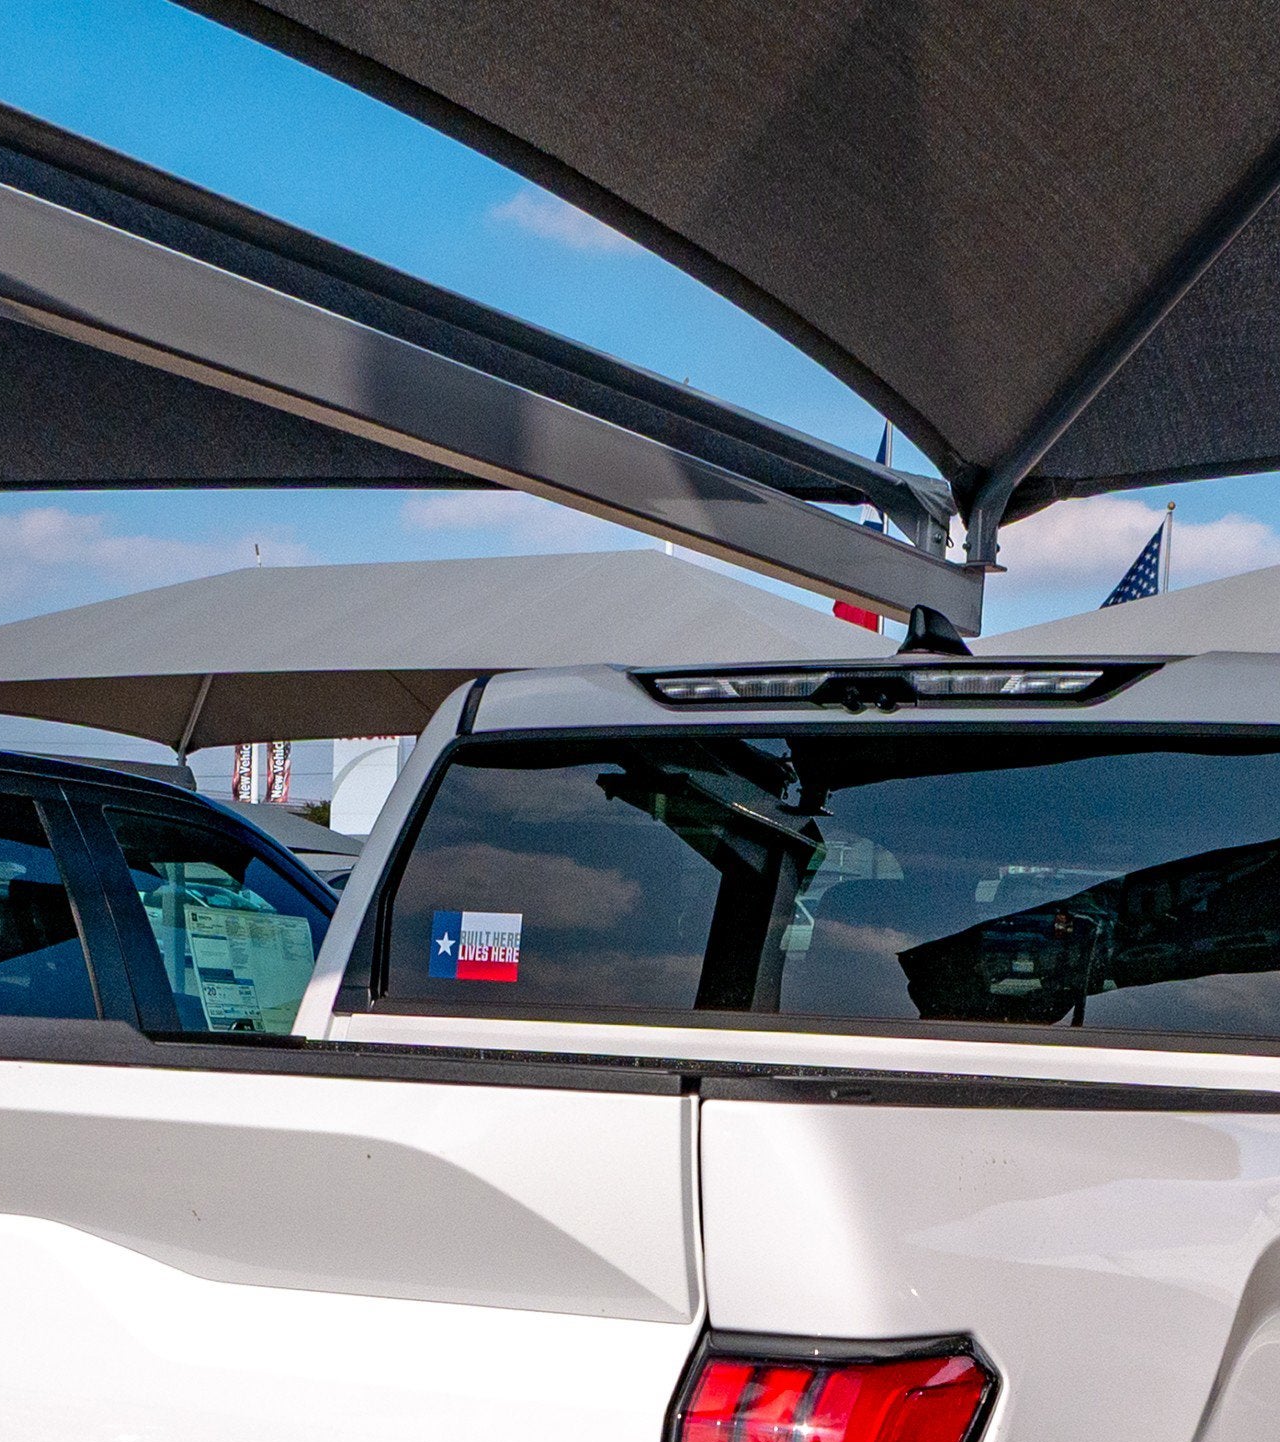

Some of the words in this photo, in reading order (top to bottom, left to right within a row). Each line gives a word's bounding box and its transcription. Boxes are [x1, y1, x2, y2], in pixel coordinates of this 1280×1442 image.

[460, 930, 491, 946] BUILT
[493, 931, 521, 948] HERE
[458, 944, 489, 961] LIVES
[490, 946, 520, 963] HERE
